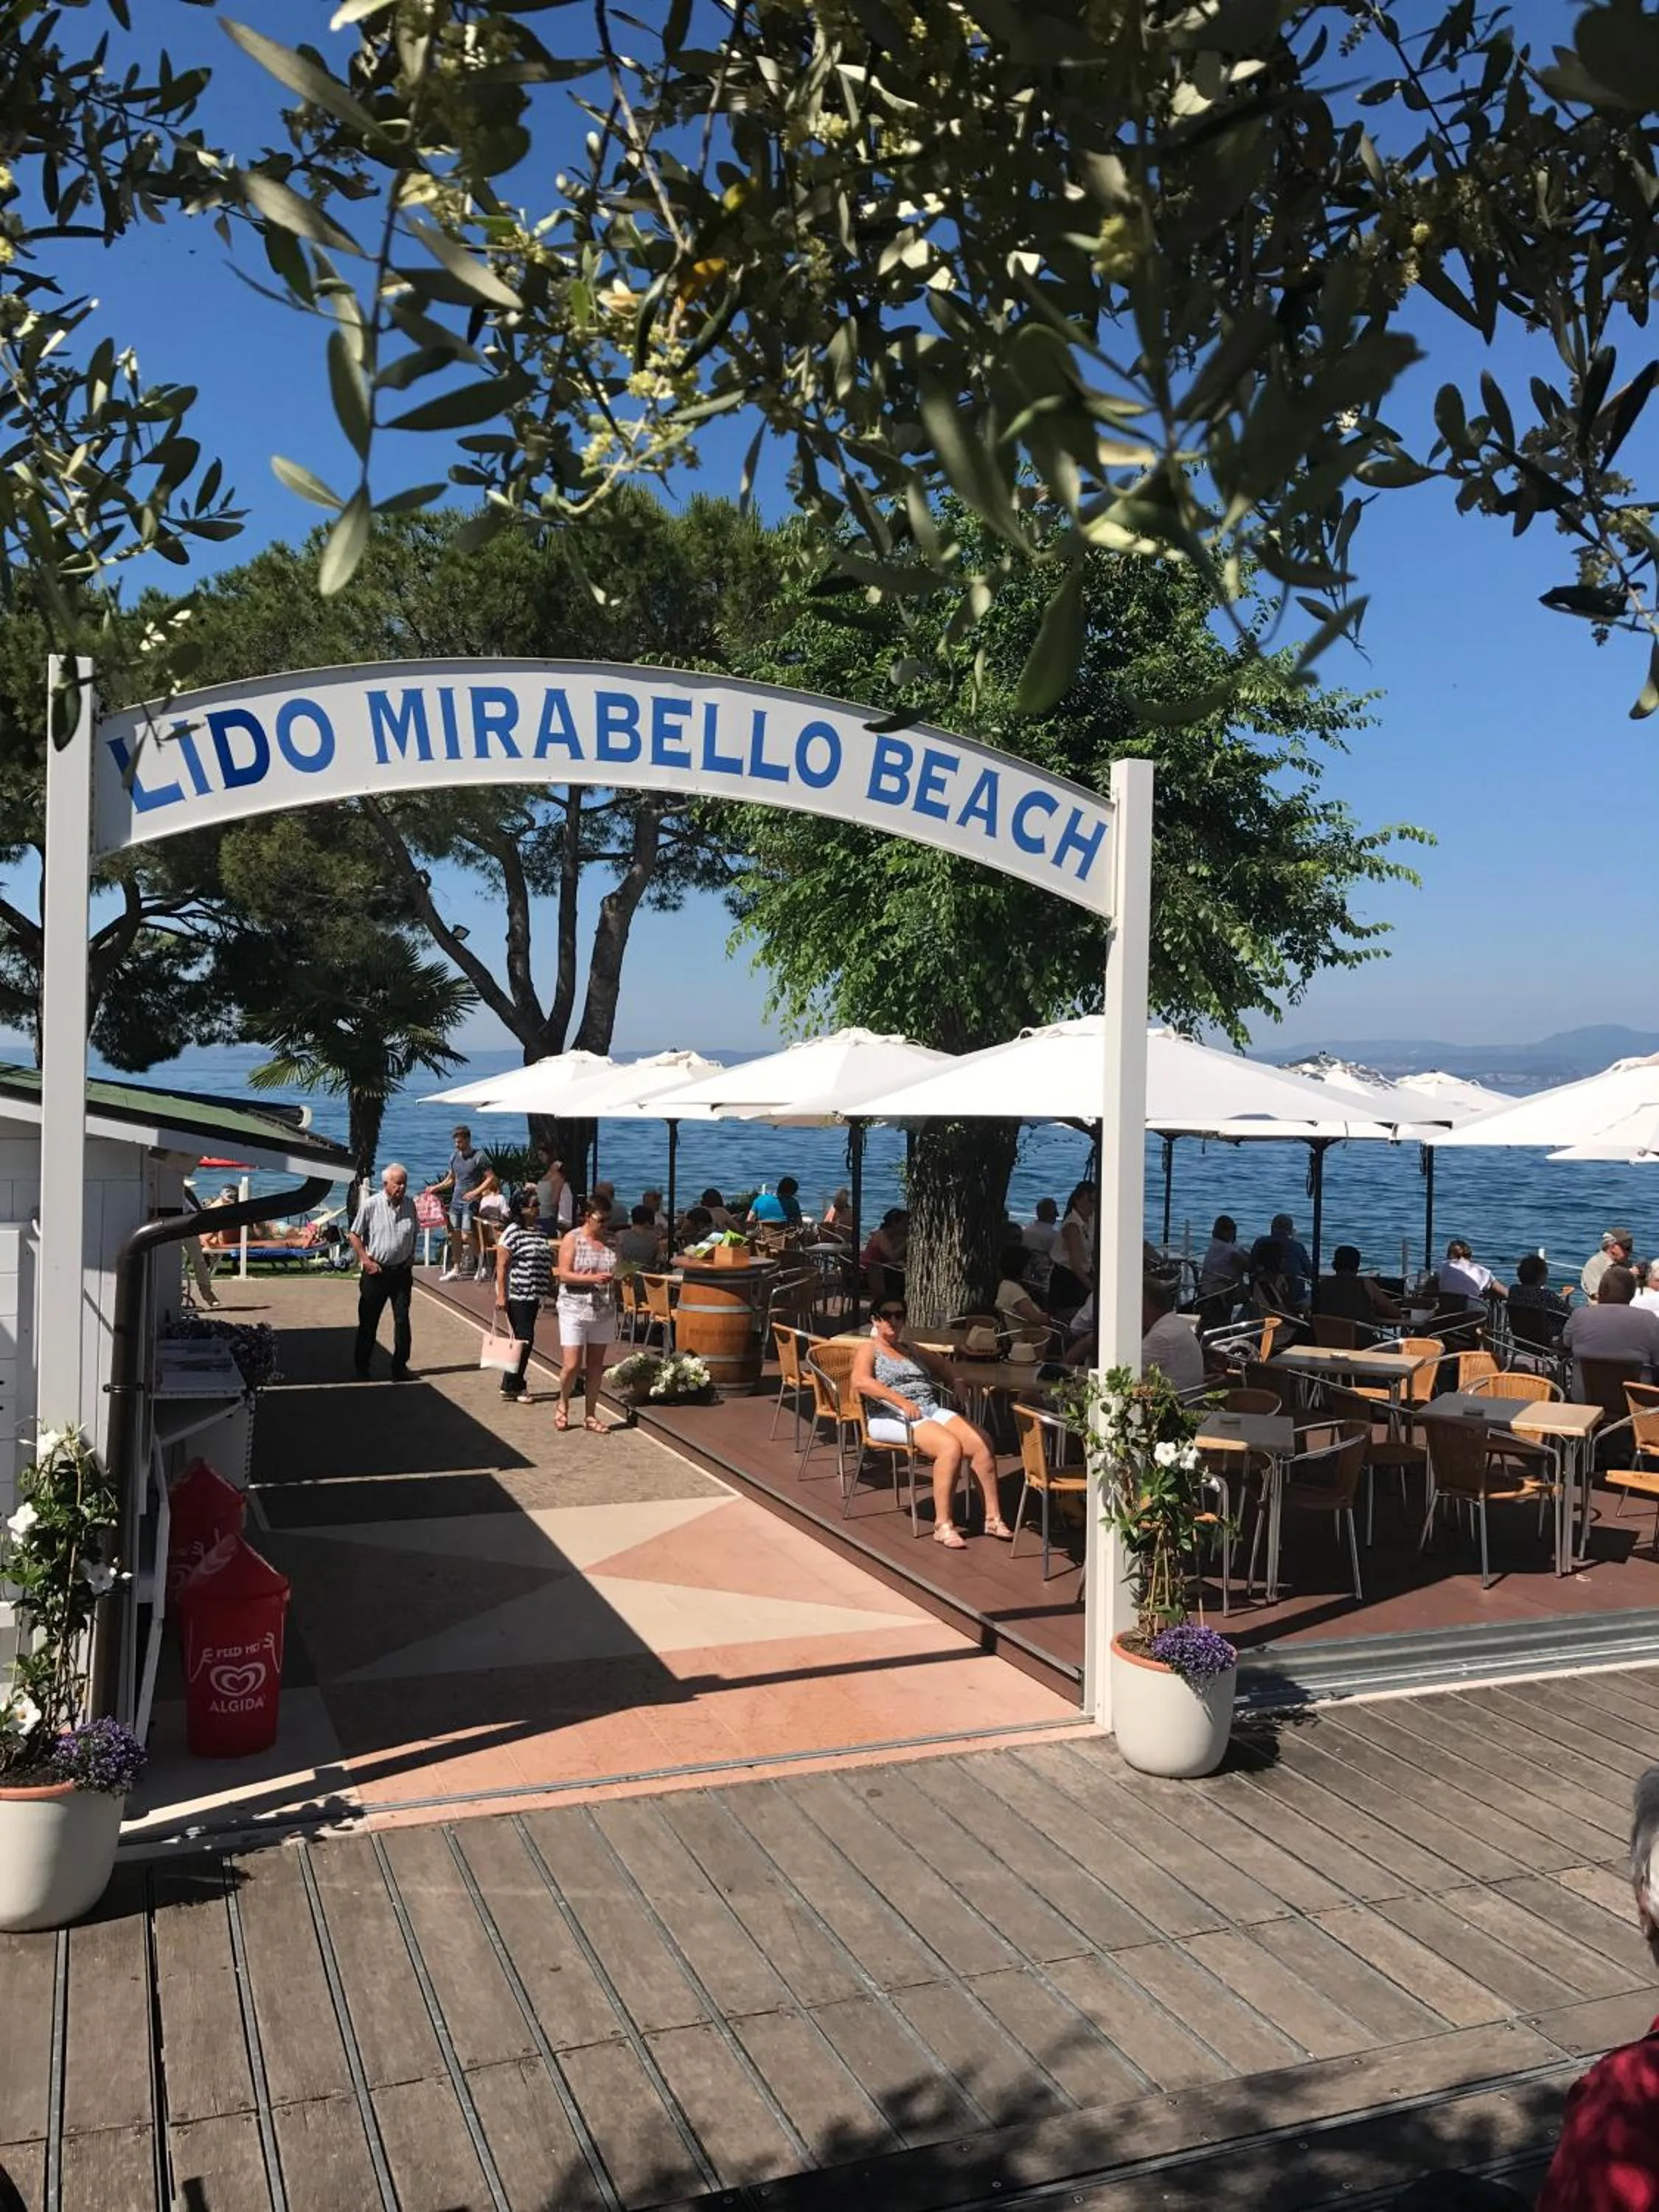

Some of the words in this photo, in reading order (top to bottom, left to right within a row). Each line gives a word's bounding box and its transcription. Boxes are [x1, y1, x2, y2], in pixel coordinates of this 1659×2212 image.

[108, 698, 335, 813] LIDO
[366, 686, 841, 788] MIRABELLO
[866, 734, 1108, 881] BEACH
[208, 1698, 265, 1712] ALGIDA
